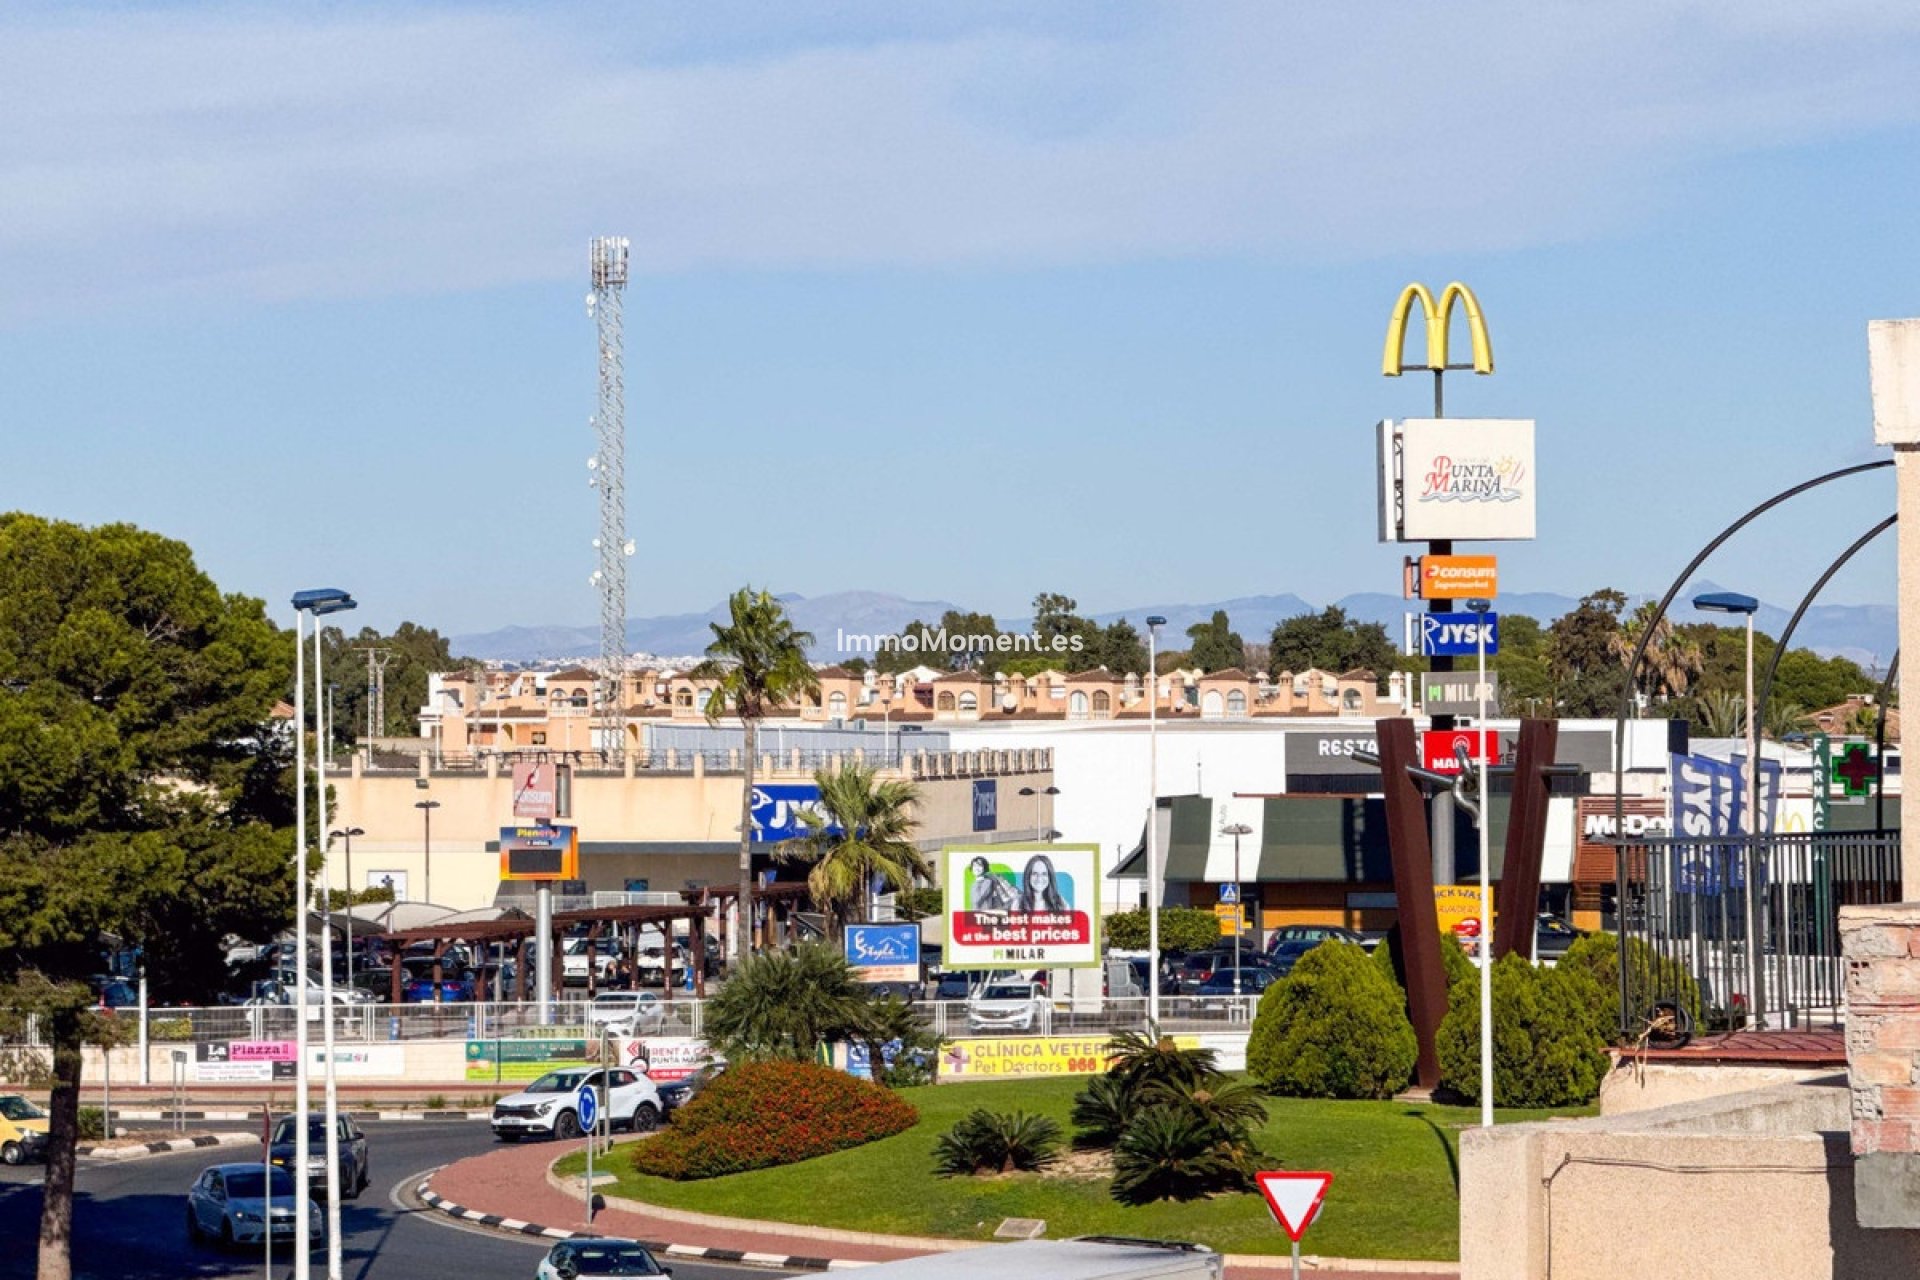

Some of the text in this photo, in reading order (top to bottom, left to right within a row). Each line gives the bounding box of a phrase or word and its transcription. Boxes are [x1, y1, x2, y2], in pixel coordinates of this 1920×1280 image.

[1433, 455, 1494, 478] PUNTA
[1421, 472, 1501, 497] MARINA
[1438, 623, 1494, 643] JYSK
[974, 913, 998, 925] The
[1032, 913, 1072, 925] makes
[992, 928, 1027, 941] best
[1032, 928, 1080, 944] prices
[1006, 948, 1045, 960] MILAR
[208, 1044, 280, 1055] La Piazza
[975, 1042, 1043, 1057] CLÍNICA
[975, 1060, 996, 1073] Pet
[1003, 1058, 1062, 1073] Doctors
